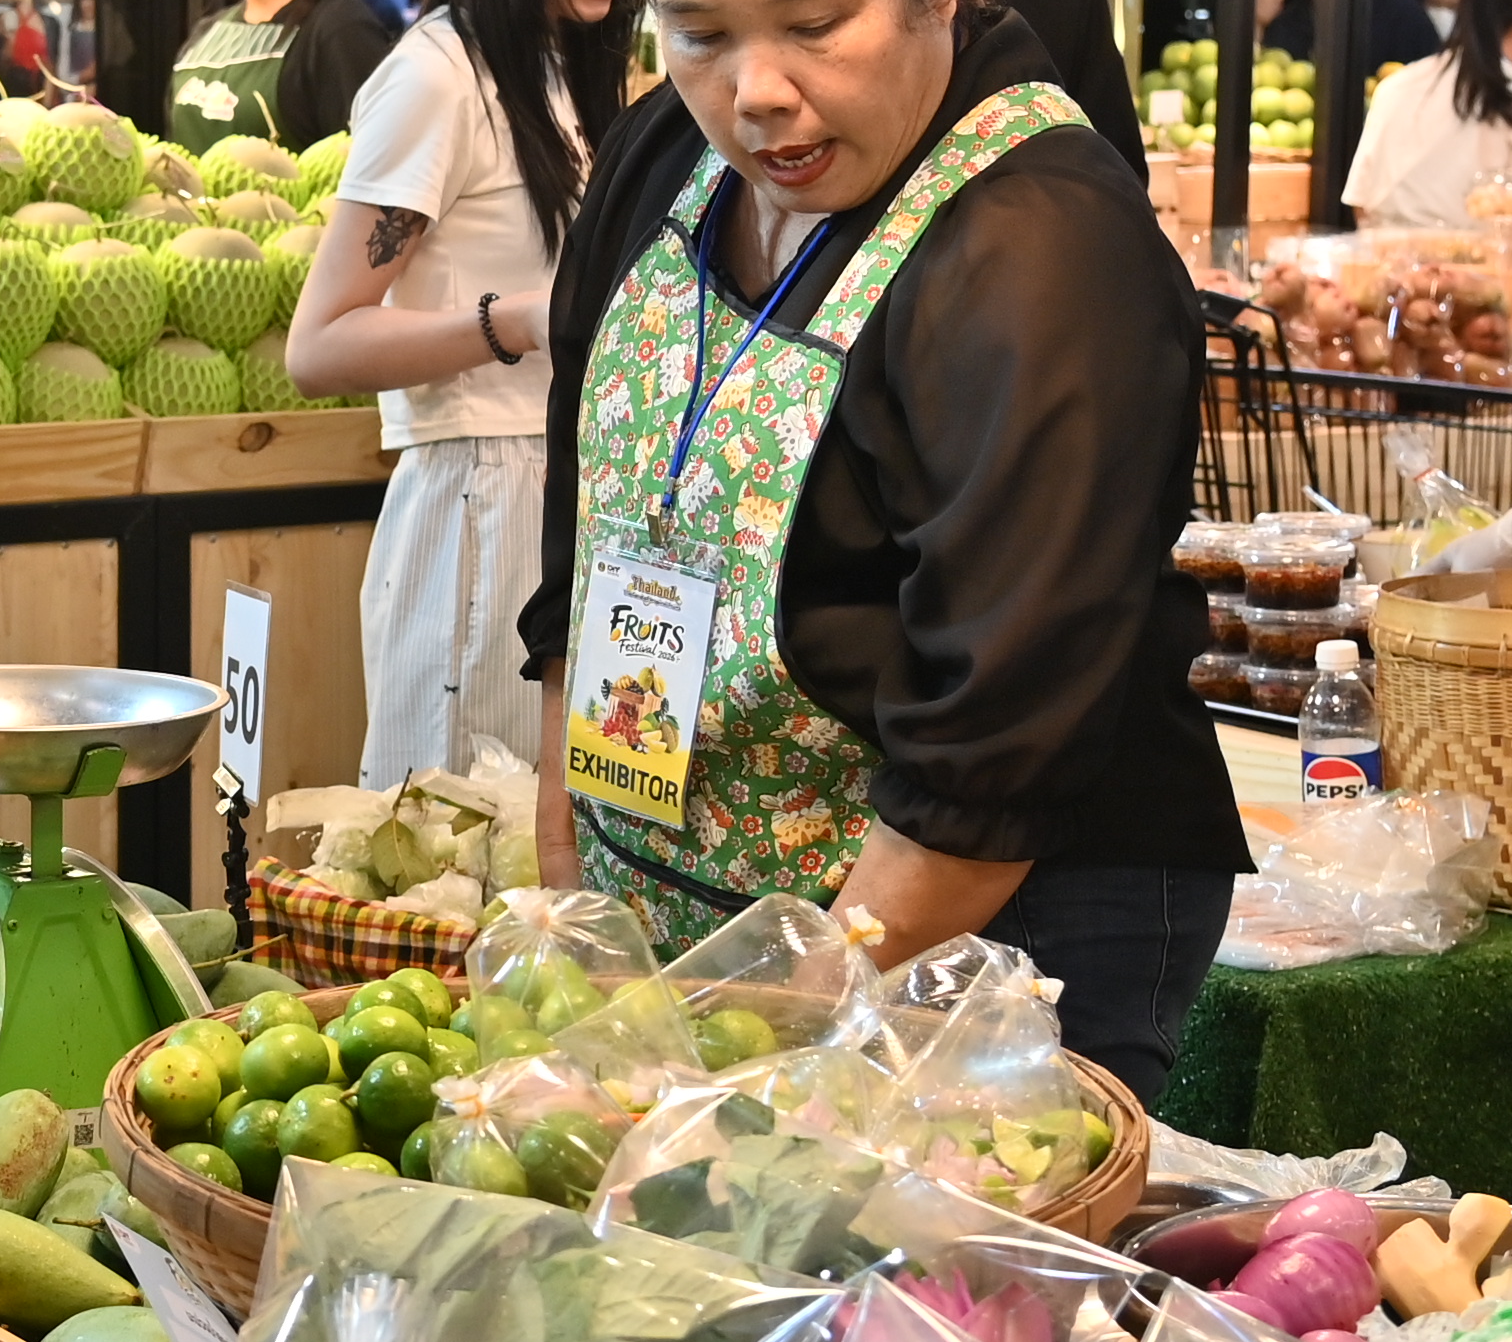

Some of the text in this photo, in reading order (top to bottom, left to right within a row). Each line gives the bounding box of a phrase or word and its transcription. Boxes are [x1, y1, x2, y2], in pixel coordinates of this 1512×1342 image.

[618, 638, 658, 656] Festival
[224, 655, 260, 746] 50
[569, 745, 680, 809] EXHIBITOR
